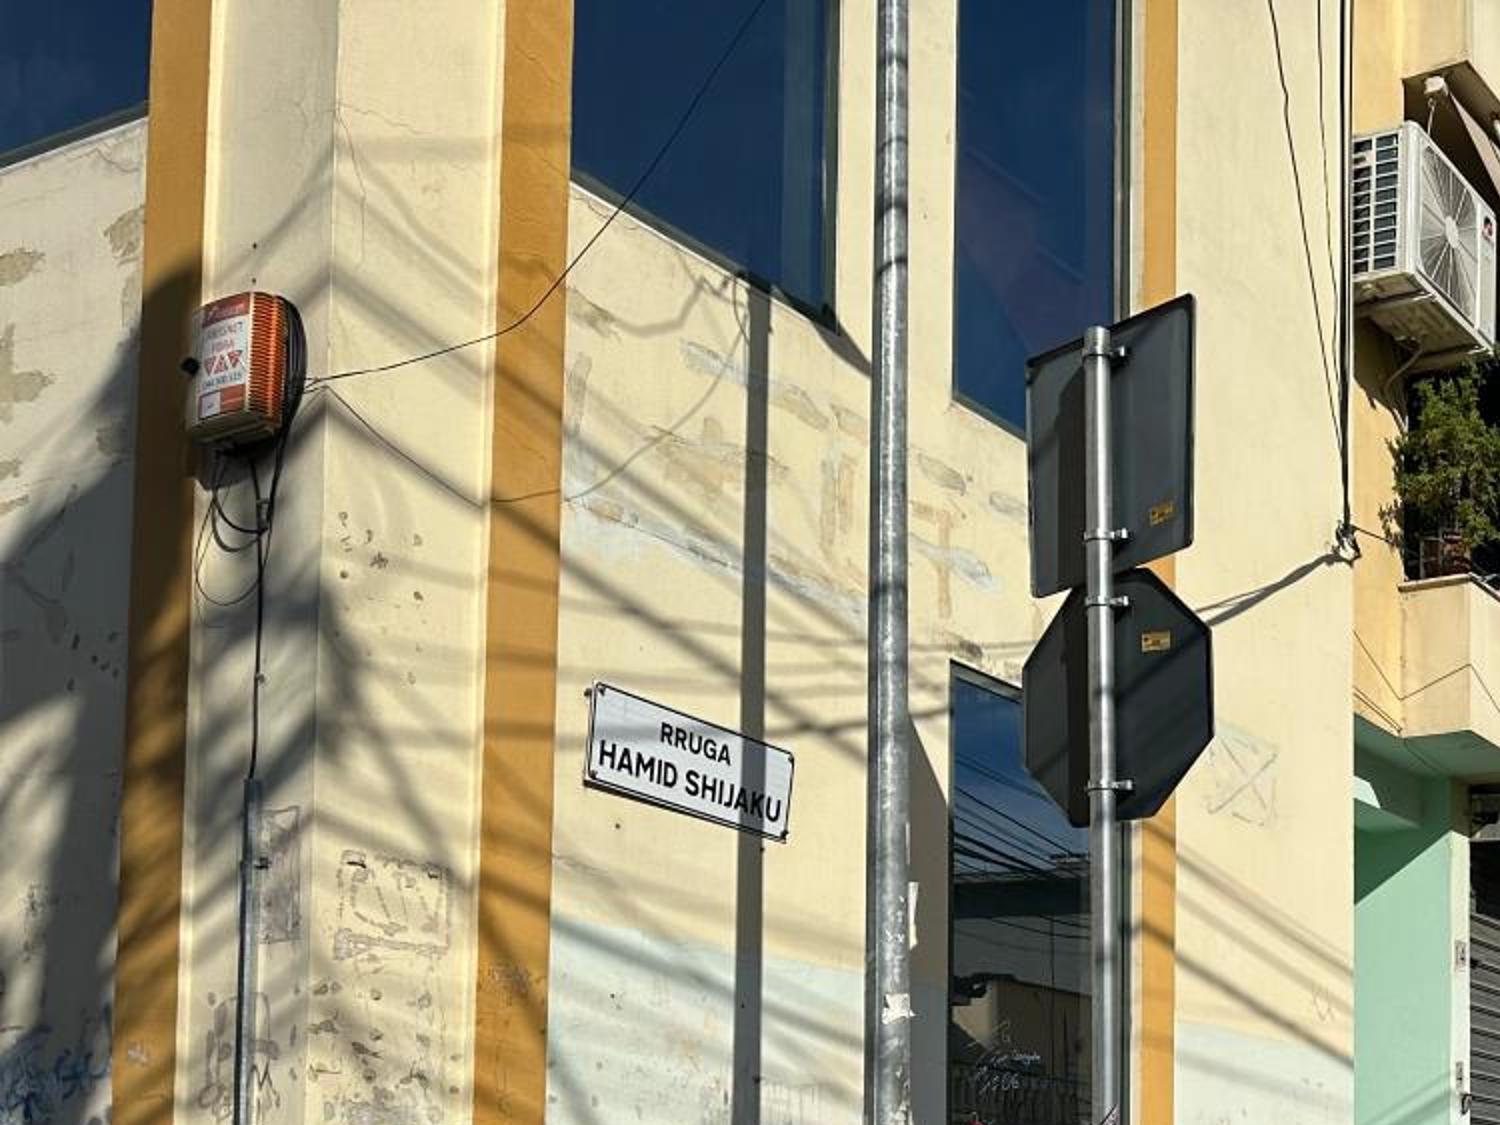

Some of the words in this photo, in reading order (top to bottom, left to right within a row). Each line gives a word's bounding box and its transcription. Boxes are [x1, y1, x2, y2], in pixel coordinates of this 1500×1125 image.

[660, 722, 731, 766] RRUGA
[599, 739, 678, 788] HAMID
[685, 770, 781, 822] SHIJAKU
